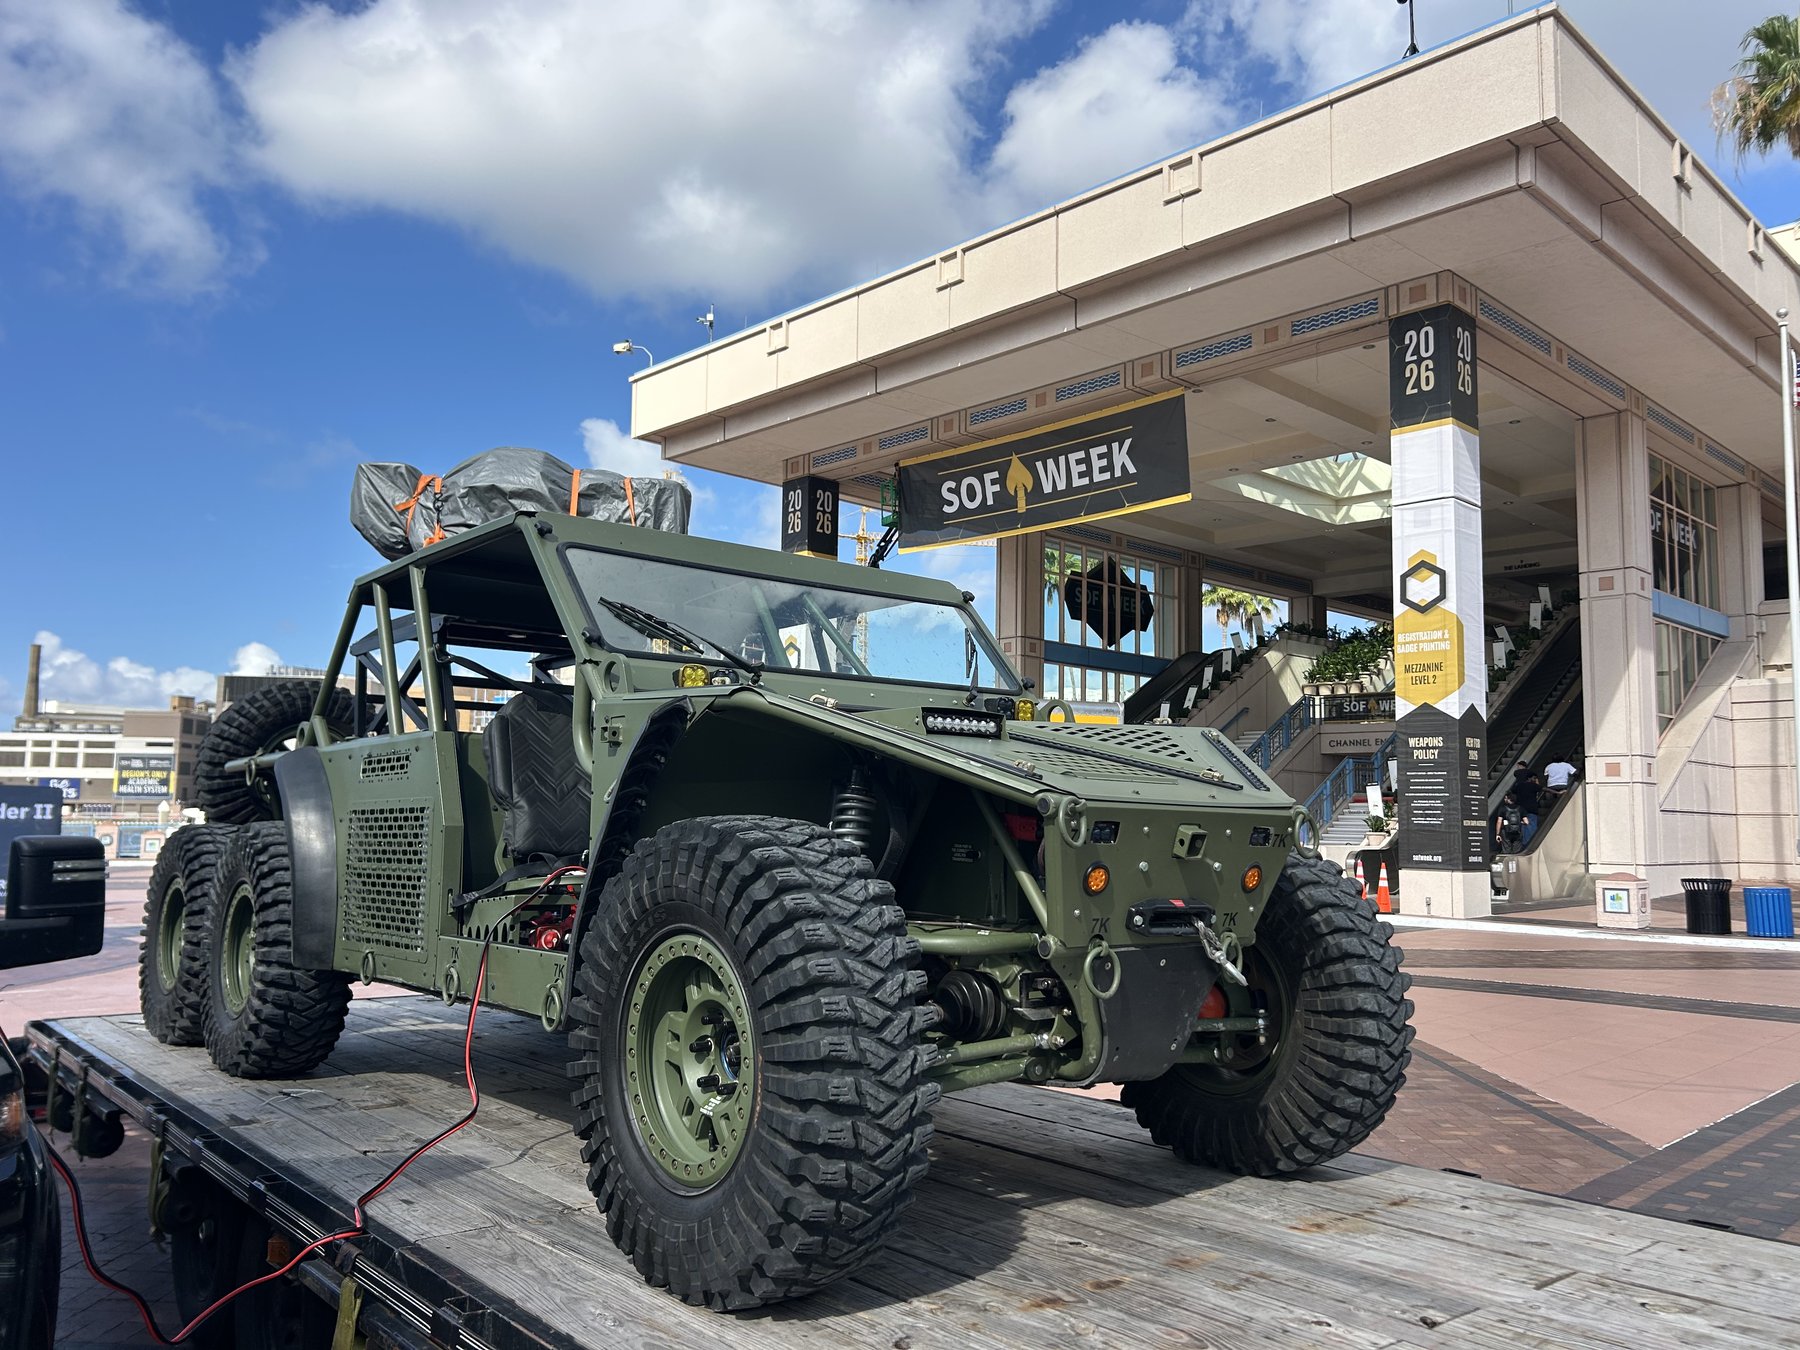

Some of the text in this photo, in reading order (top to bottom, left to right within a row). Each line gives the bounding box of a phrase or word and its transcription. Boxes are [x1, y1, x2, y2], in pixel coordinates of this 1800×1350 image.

[1404, 326, 1434, 362] 20
[1457, 327, 1471, 362] 20
[1405, 359, 1434, 395] 26
[1457, 360, 1472, 395] 26
[941, 437, 1137, 513] SOF WEEK
[788, 489, 802, 512] 20
[816, 489, 832, 512] 20
[788, 511, 801, 534] 26
[816, 511, 831, 534] 26
[1650, 509, 1661, 532] OF
[1397, 629, 1449, 642] REGISTRATION &
[1397, 641, 1451, 654] BADGE PRINTING
[1404, 662, 1443, 673] MEZZANINE
[1411, 675, 1437, 685] LEVEL 2
[1343, 700, 1396, 712] SOF WE
[1329, 738, 1387, 748] CHANNEL EN
[1408, 737, 1443, 747] WEAPONS
[1413, 749, 1439, 759] POLICY
[151, 770, 167, 778] ONLY
[119, 784, 168, 793] HEALTH SYSTEM
[33, 803, 54, 819] II
[1272, 833, 1288, 848] 7K
[1091, 917, 1110, 934] 7K
[1222, 912, 1239, 927] 7K
[451, 946, 460, 960] 7K
[554, 963, 565, 979] 7K
